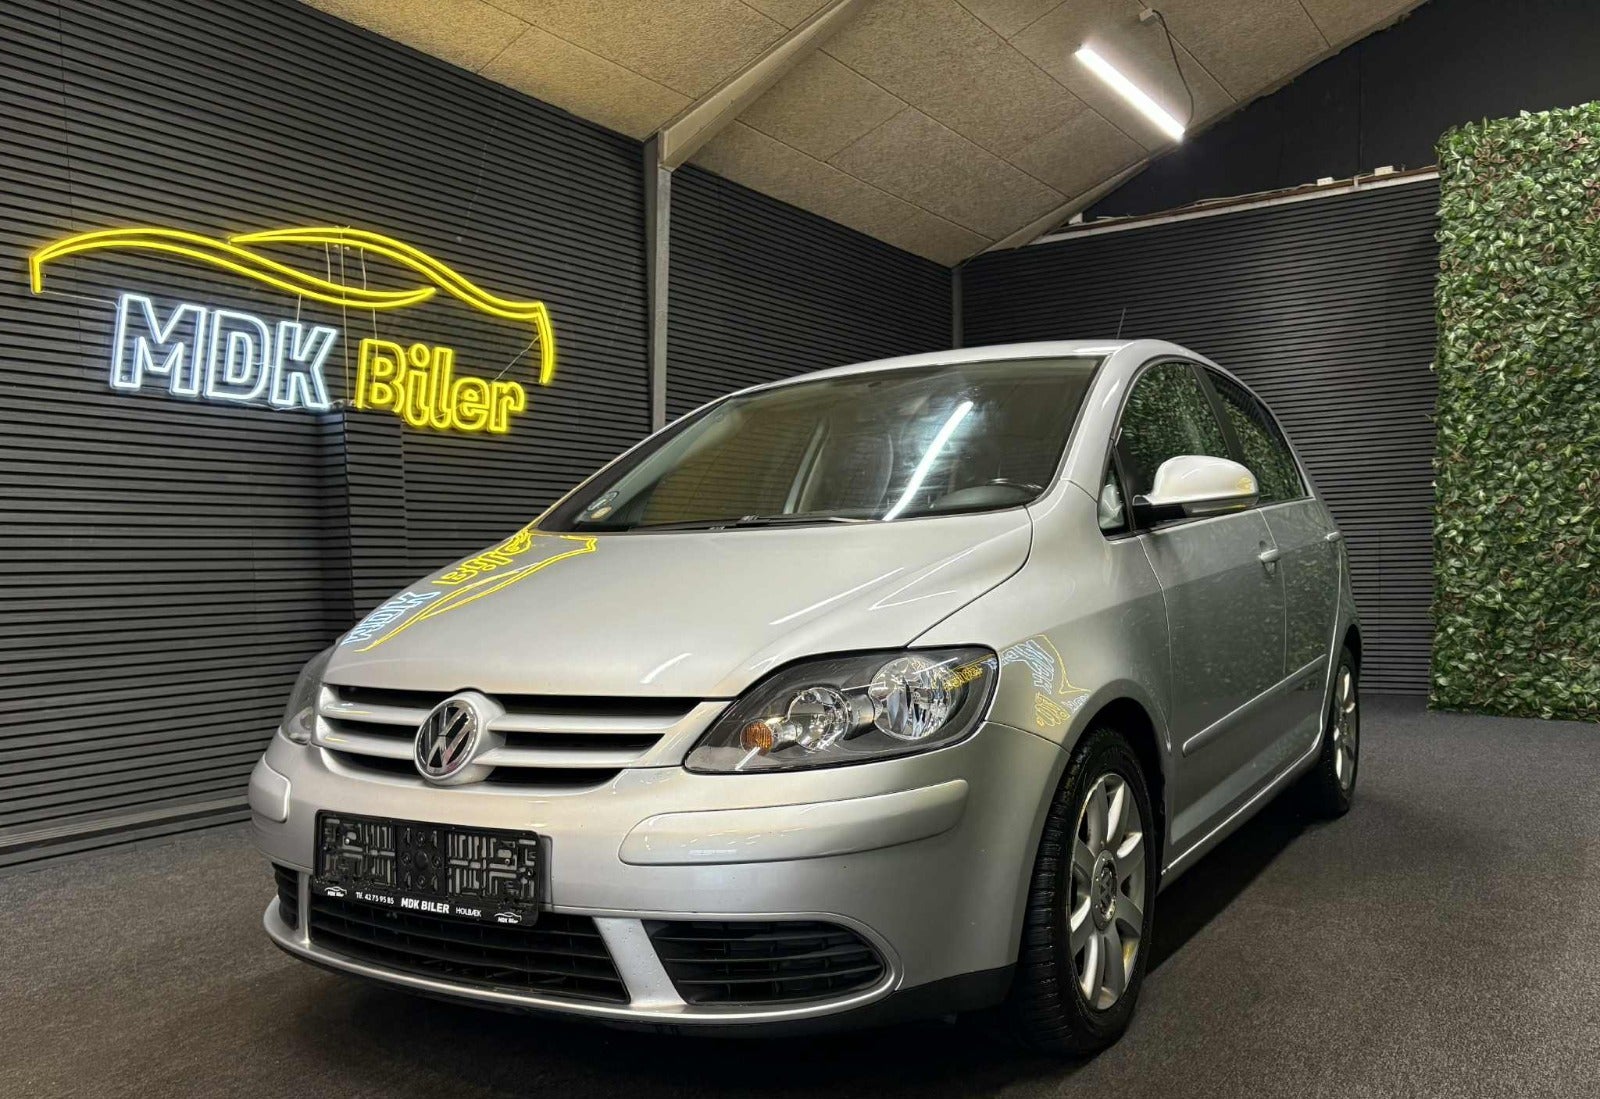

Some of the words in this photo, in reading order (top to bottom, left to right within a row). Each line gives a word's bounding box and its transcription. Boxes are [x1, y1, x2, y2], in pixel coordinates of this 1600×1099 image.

[109, 293, 338, 410] MDK
[355, 338, 526, 433] Biler
[401, 897, 420, 909] MDK
[421, 901, 450, 914] BILER
